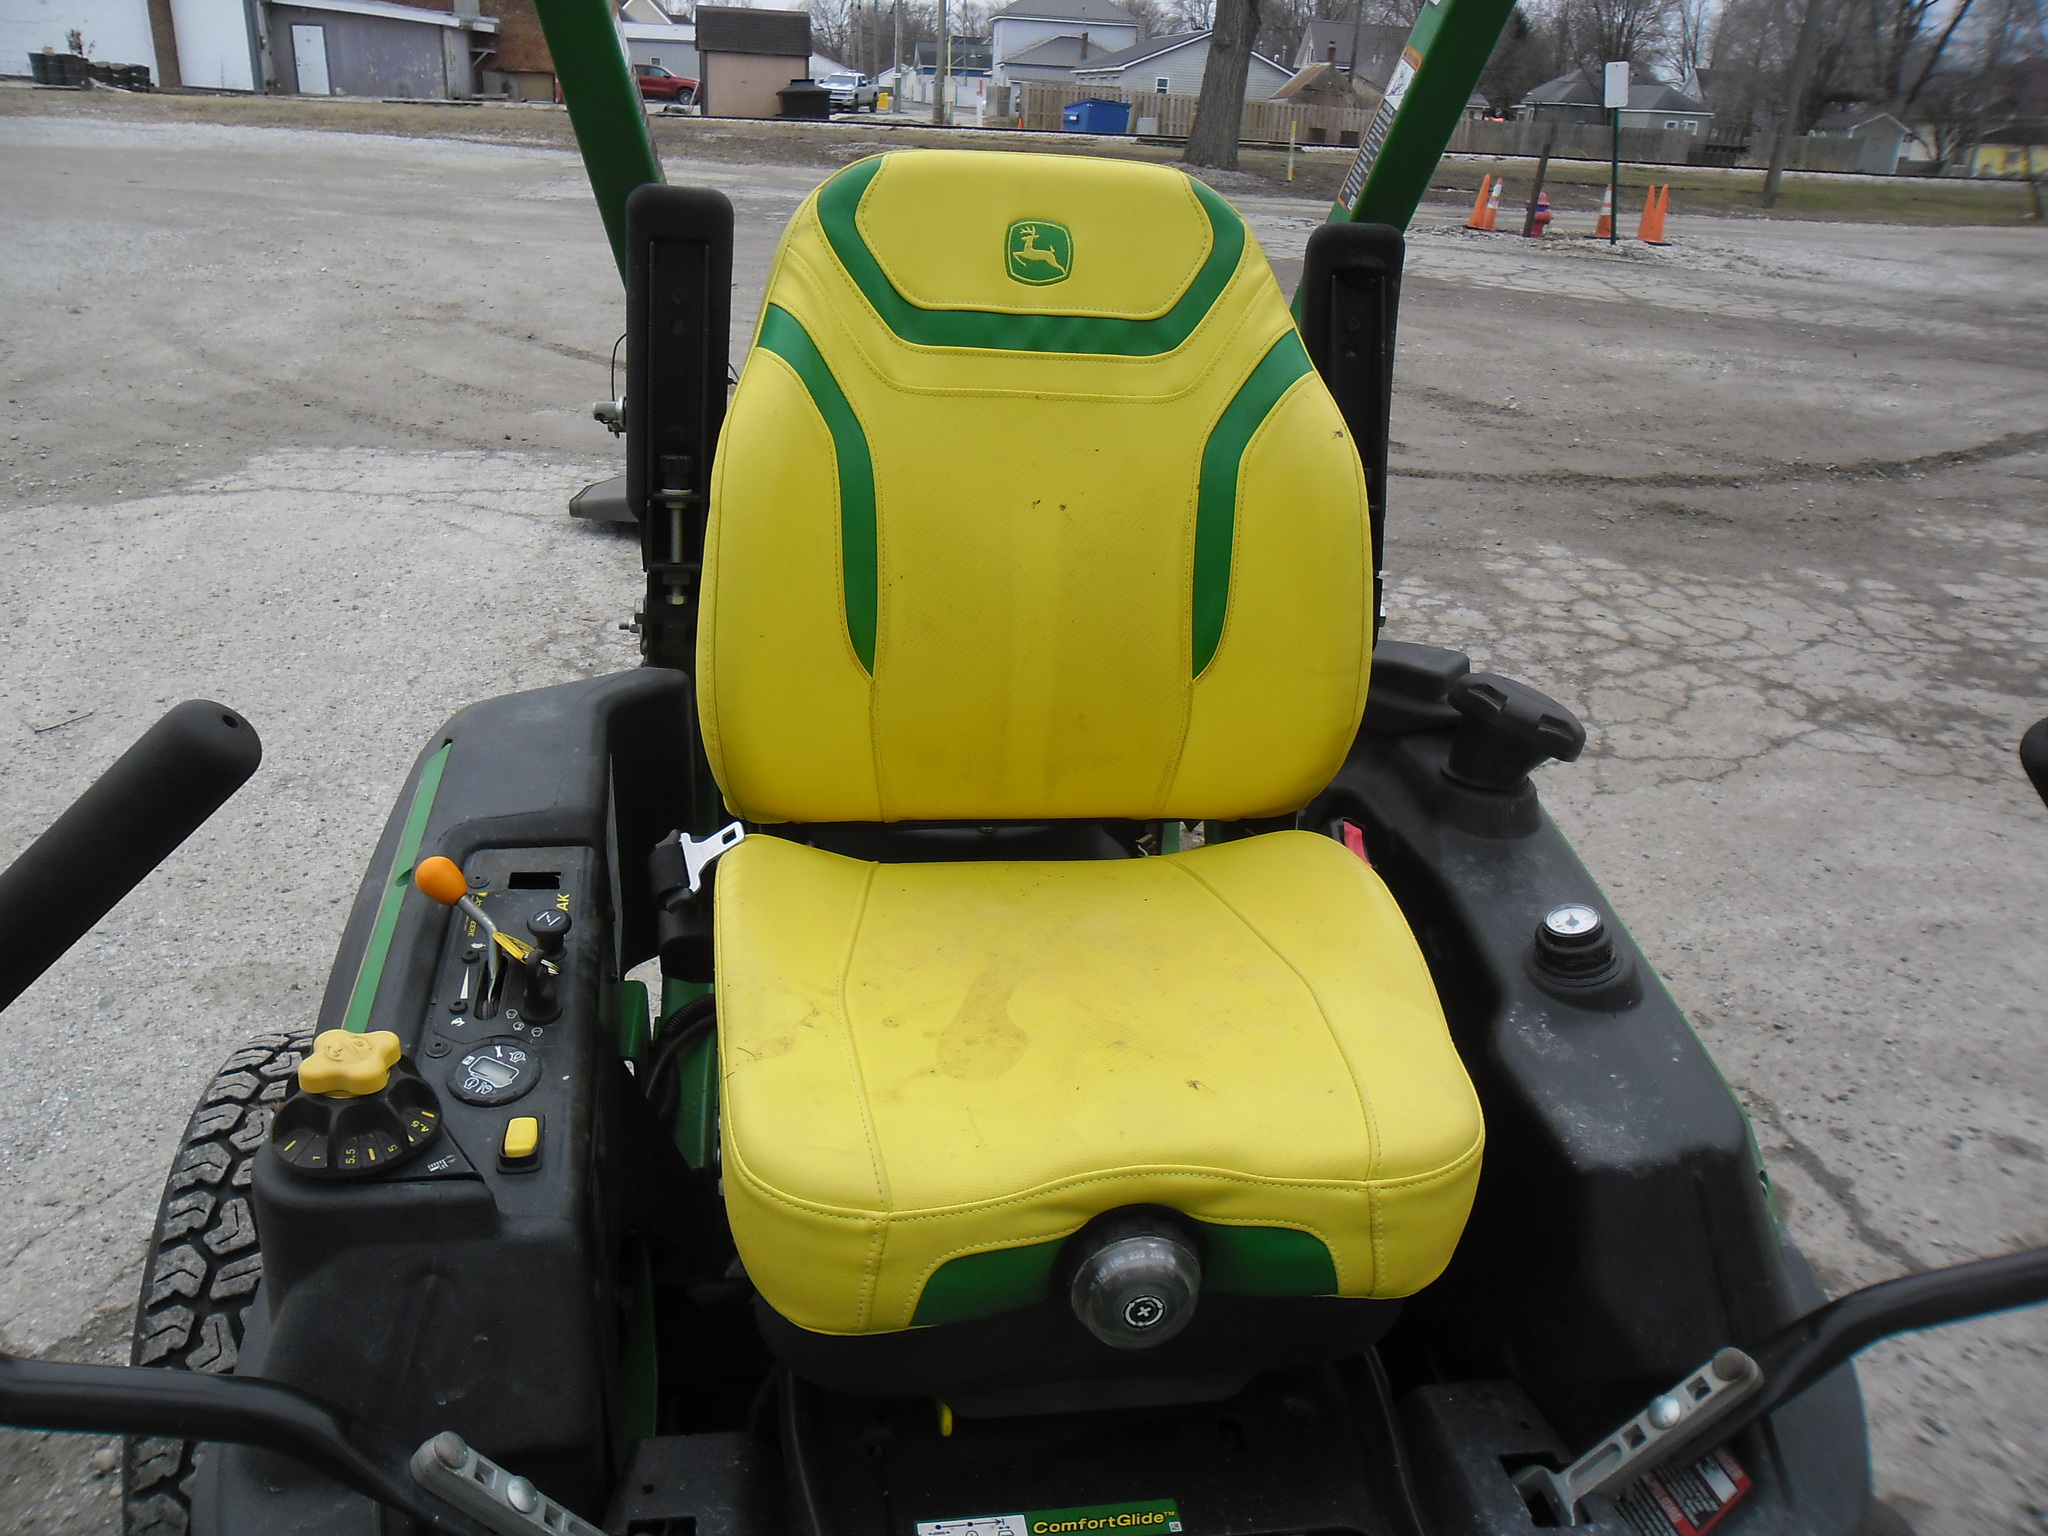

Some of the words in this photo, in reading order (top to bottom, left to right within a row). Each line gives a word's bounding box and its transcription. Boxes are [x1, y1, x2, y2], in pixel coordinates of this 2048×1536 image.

[556, 893, 571, 911] AK
[467, 920, 477, 937] EERE
[410, 1119, 430, 1133] 4.5
[345, 1148, 356, 1164] 5.5
[387, 1144, 398, 1153] 5
[1128, 1249, 1145, 1260] 235
